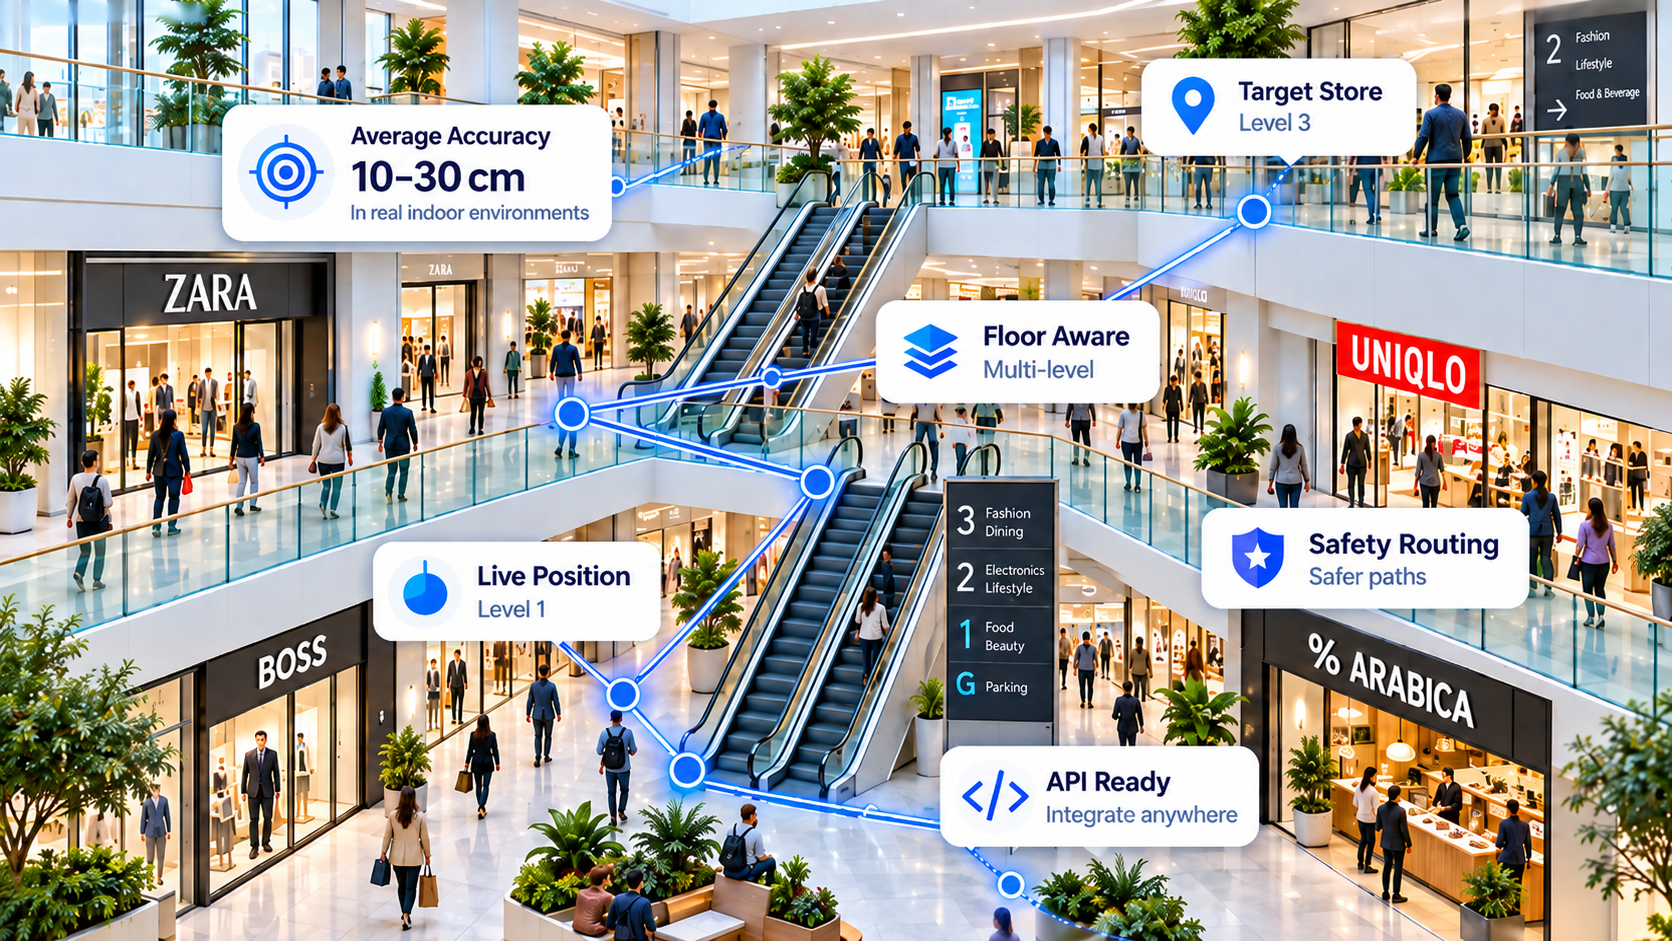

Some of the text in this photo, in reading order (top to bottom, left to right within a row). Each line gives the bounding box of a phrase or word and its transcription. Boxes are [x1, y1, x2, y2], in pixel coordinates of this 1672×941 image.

[1576, 30, 1610, 43] Fashion
[1547, 34, 1561, 64] 2
[1576, 57, 1612, 71] Lifestyle
[1576, 88, 1640, 99] Food & Beverage
[429, 264, 452, 275] ZARA
[164, 274, 257, 313] ZARA
[1351, 333, 1467, 395] UNIQLO
[987, 507, 1030, 518] Fashion
[957, 505, 974, 535] 3
[986, 526, 1023, 539] Dining
[957, 562, 974, 591] 2
[986, 565, 1044, 575] Electronics
[986, 582, 1032, 596] Lifestyle
[960, 619, 970, 648] 1
[986, 622, 1014, 632] Food
[986, 640, 1024, 654] Beauty
[257, 634, 328, 690] BOSS
[957, 672, 975, 695] G
[986, 681, 1027, 695] Parking
[1349, 650, 1475, 729] ARABICA
